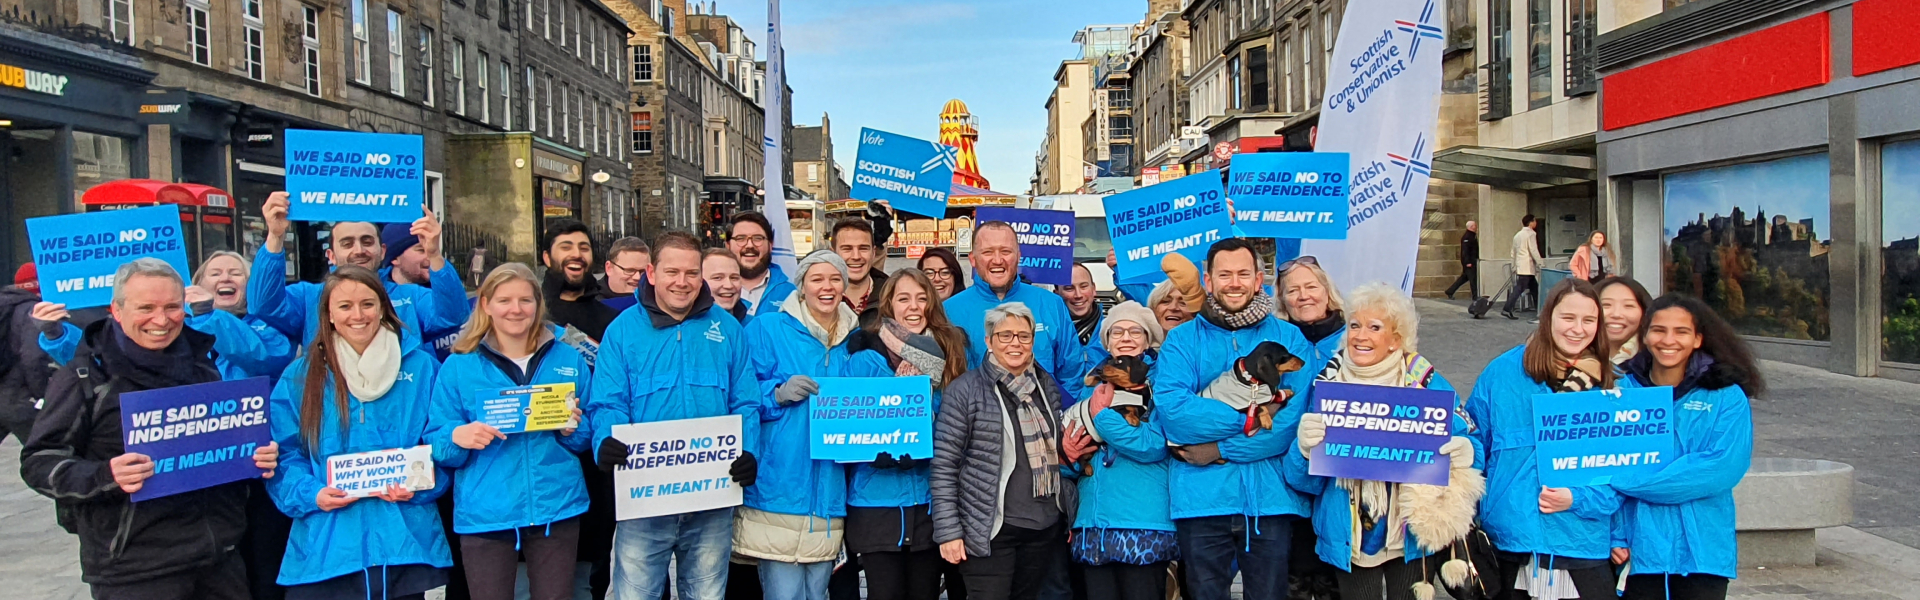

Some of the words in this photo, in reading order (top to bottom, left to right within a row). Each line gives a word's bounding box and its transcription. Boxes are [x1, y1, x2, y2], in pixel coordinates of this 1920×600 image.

[1350, 29, 1394, 74] Scottish
[0, 63, 68, 96] UBWAY
[1328, 45, 1400, 110] Conservative
[1346, 99, 1355, 113] &
[1356, 60, 1406, 104] Unionist
[138, 104, 181, 113] SUBWAY
[863, 131, 884, 146] Vote
[1184, 128, 1200, 136] CAU
[294, 150, 319, 162] WE
[323, 152, 362, 164] SAID
[366, 154, 390, 165] NO
[396, 155, 416, 166] TO
[289, 164, 418, 180] INDEPENDENCE.
[858, 160, 916, 180] SCOTTISH
[1234, 172, 1254, 183] WE
[1257, 172, 1292, 183] SAID
[1295, 172, 1318, 183] NO
[1322, 172, 1342, 183] TO
[856, 174, 946, 202] CONSERVATIVE
[1229, 184, 1344, 196] INDEPENDENCE.
[300, 192, 327, 204] WE
[330, 193, 388, 206] MEANT
[392, 194, 408, 206] IT.
[1112, 210, 1134, 225] WE
[1138, 202, 1170, 218] SAID
[1174, 195, 1196, 210] NO
[1199, 190, 1218, 203] TO
[1112, 202, 1224, 238] INDEPENDENCE.
[1238, 210, 1259, 221] WE
[1262, 211, 1315, 222] MEANT
[1317, 212, 1334, 223] IT.
[40, 236, 68, 250] WE
[73, 232, 115, 247] SAID
[120, 228, 146, 242] NO
[152, 226, 174, 238] TO
[1032, 224, 1050, 234] NO
[1054, 224, 1070, 235] TO
[38, 239, 180, 265] INDEPENDENCE.
[1127, 248, 1149, 262] WE
[1152, 233, 1202, 255] MEANT
[1206, 229, 1220, 242] IT.
[1018, 257, 1048, 268] EANT
[1048, 259, 1061, 269] IT.
[56, 278, 84, 292] WE
[816, 396, 838, 407] WE
[842, 396, 876, 406] SAID
[879, 395, 901, 406] NO
[906, 394, 924, 404] TO
[132, 410, 162, 428] WE
[166, 404, 207, 422] SAID
[211, 400, 237, 415] NO
[241, 396, 264, 411] TO
[812, 407, 927, 419] INDEPENDENCE.
[1321, 399, 1347, 412] WE
[1349, 401, 1390, 416] SAID
[1393, 404, 1419, 418] NO
[1424, 407, 1447, 421] TO
[1542, 414, 1567, 426] WE
[1571, 411, 1610, 425] SAID
[1614, 409, 1641, 423] NO
[1645, 408, 1666, 421] TO
[128, 411, 267, 445] INDEPENDENCE.
[1321, 414, 1448, 436] NDEPENDENCE.
[1538, 422, 1670, 441] INDEPENDENCE.
[649, 439, 685, 453] SAID
[690, 437, 712, 449] NO
[717, 435, 736, 447] TO
[823, 433, 846, 444] WE
[848, 429, 901, 444] MEANT
[903, 432, 919, 443] IT.
[178, 445, 237, 470] MEANT
[334, 460, 353, 469] WE
[356, 456, 383, 467] SAID
[386, 454, 406, 463] NO.
[1325, 443, 1350, 456] WE
[1353, 445, 1414, 462] MEANT
[1416, 450, 1435, 464] IT.
[1552, 457, 1578, 470] WE
[1581, 453, 1640, 468] MEANT
[1644, 451, 1661, 464] IT.
[335, 469, 364, 480] WHY
[366, 464, 406, 477] WON'T
[336, 480, 359, 491] SHE
[362, 476, 407, 489] LISTEN?
[630, 486, 654, 499] WE
[658, 479, 712, 496] MEANT
[715, 477, 730, 489] IT.
